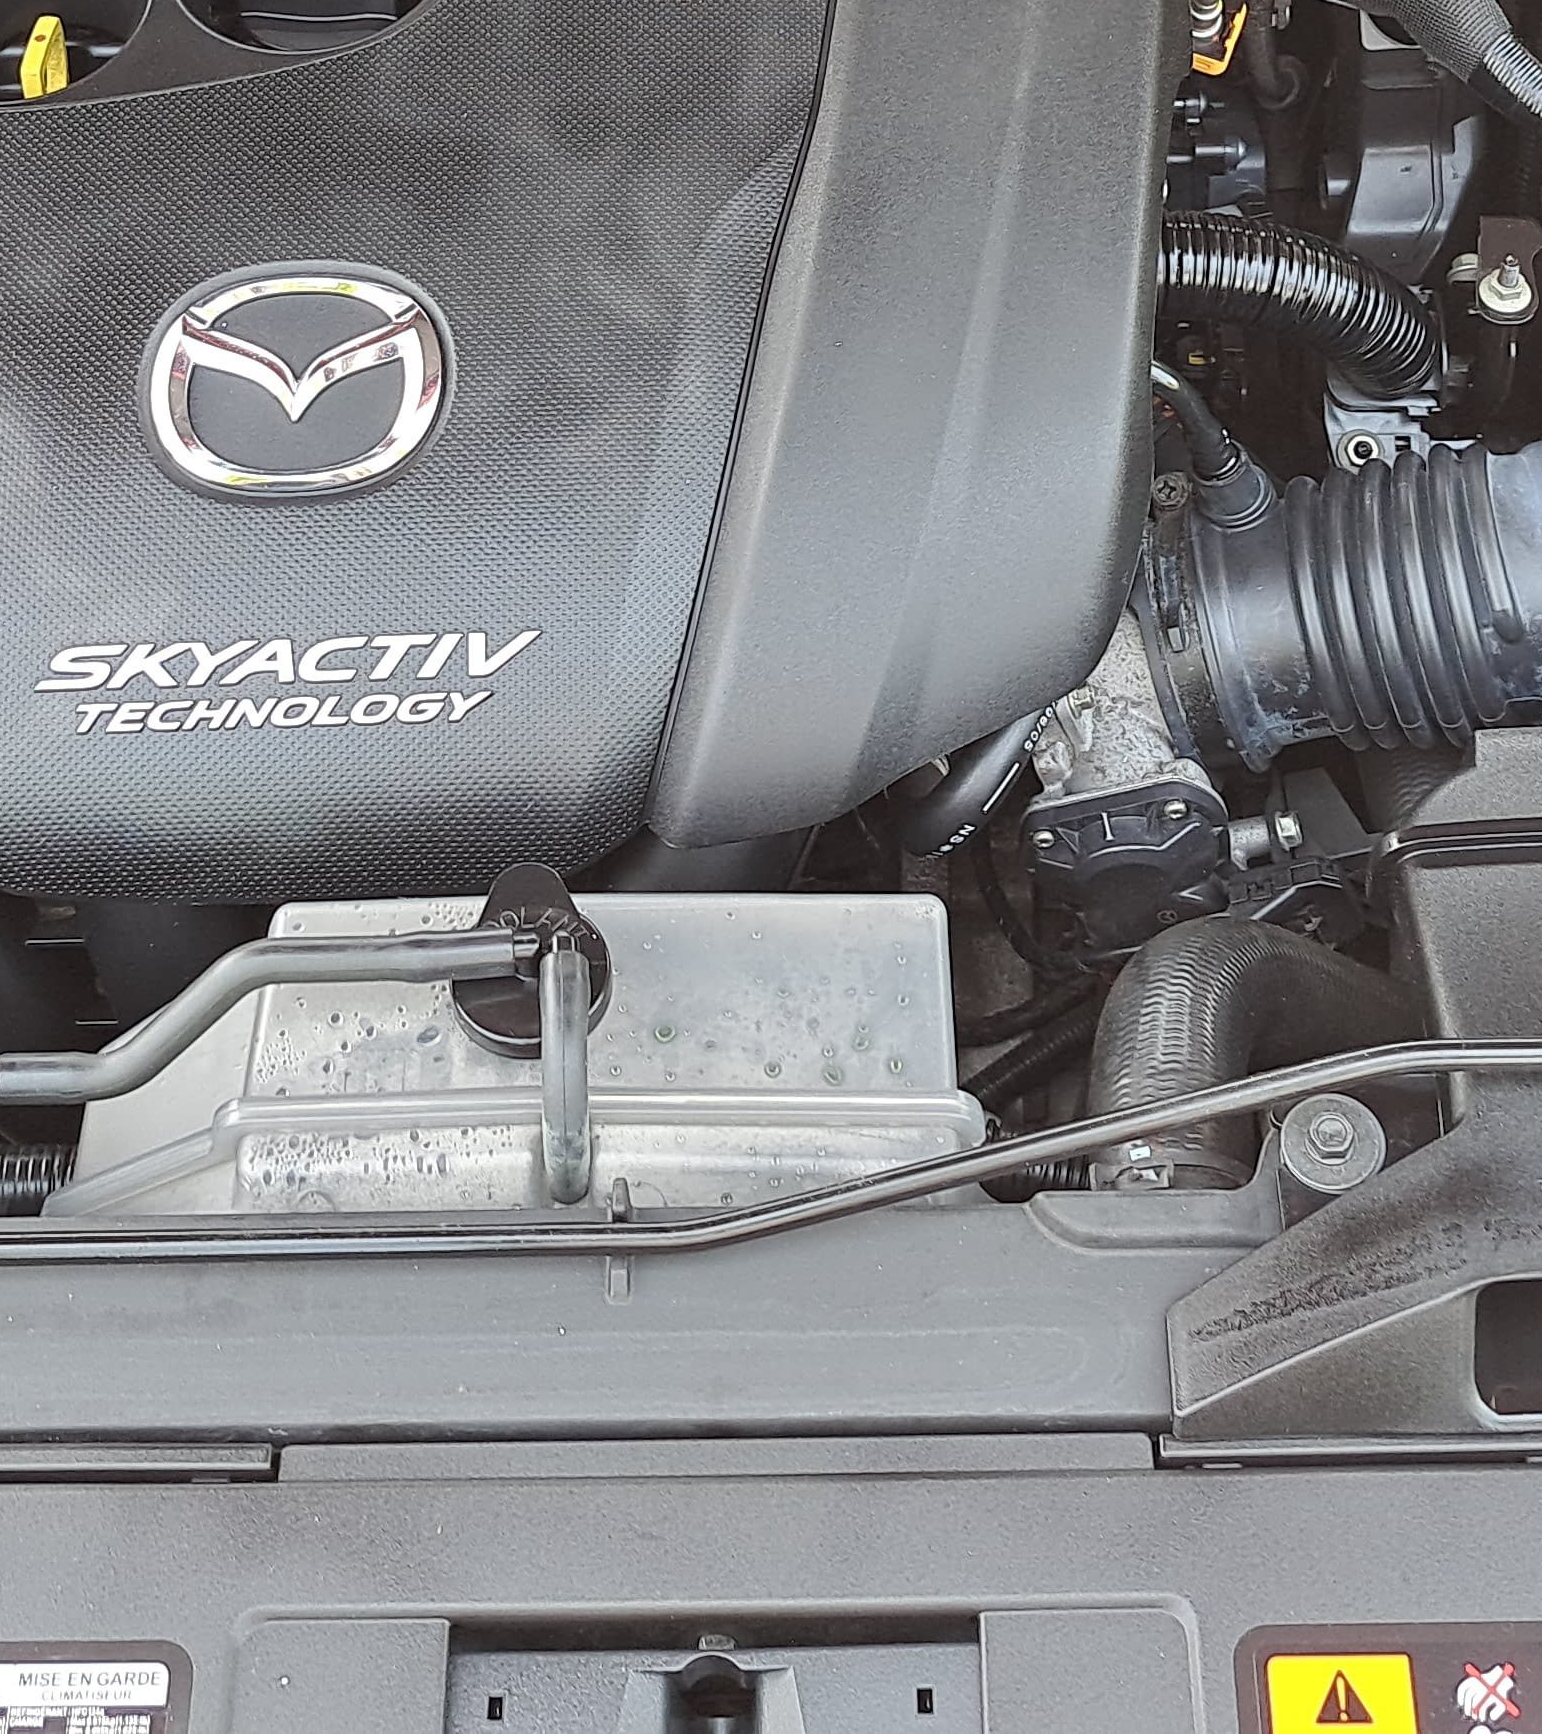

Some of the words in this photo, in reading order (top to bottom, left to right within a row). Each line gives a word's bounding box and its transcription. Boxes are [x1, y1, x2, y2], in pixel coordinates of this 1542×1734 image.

[33, 630, 543, 692] SKYACTIV
[75, 689, 493, 735] TECHNOLOGY
[18, 1672, 61, 1687] MISE
[67, 1672, 93, 1687] EN
[96, 1671, 161, 1687] GARDE
[42, 1690, 133, 1702] CLIMATISEUR
